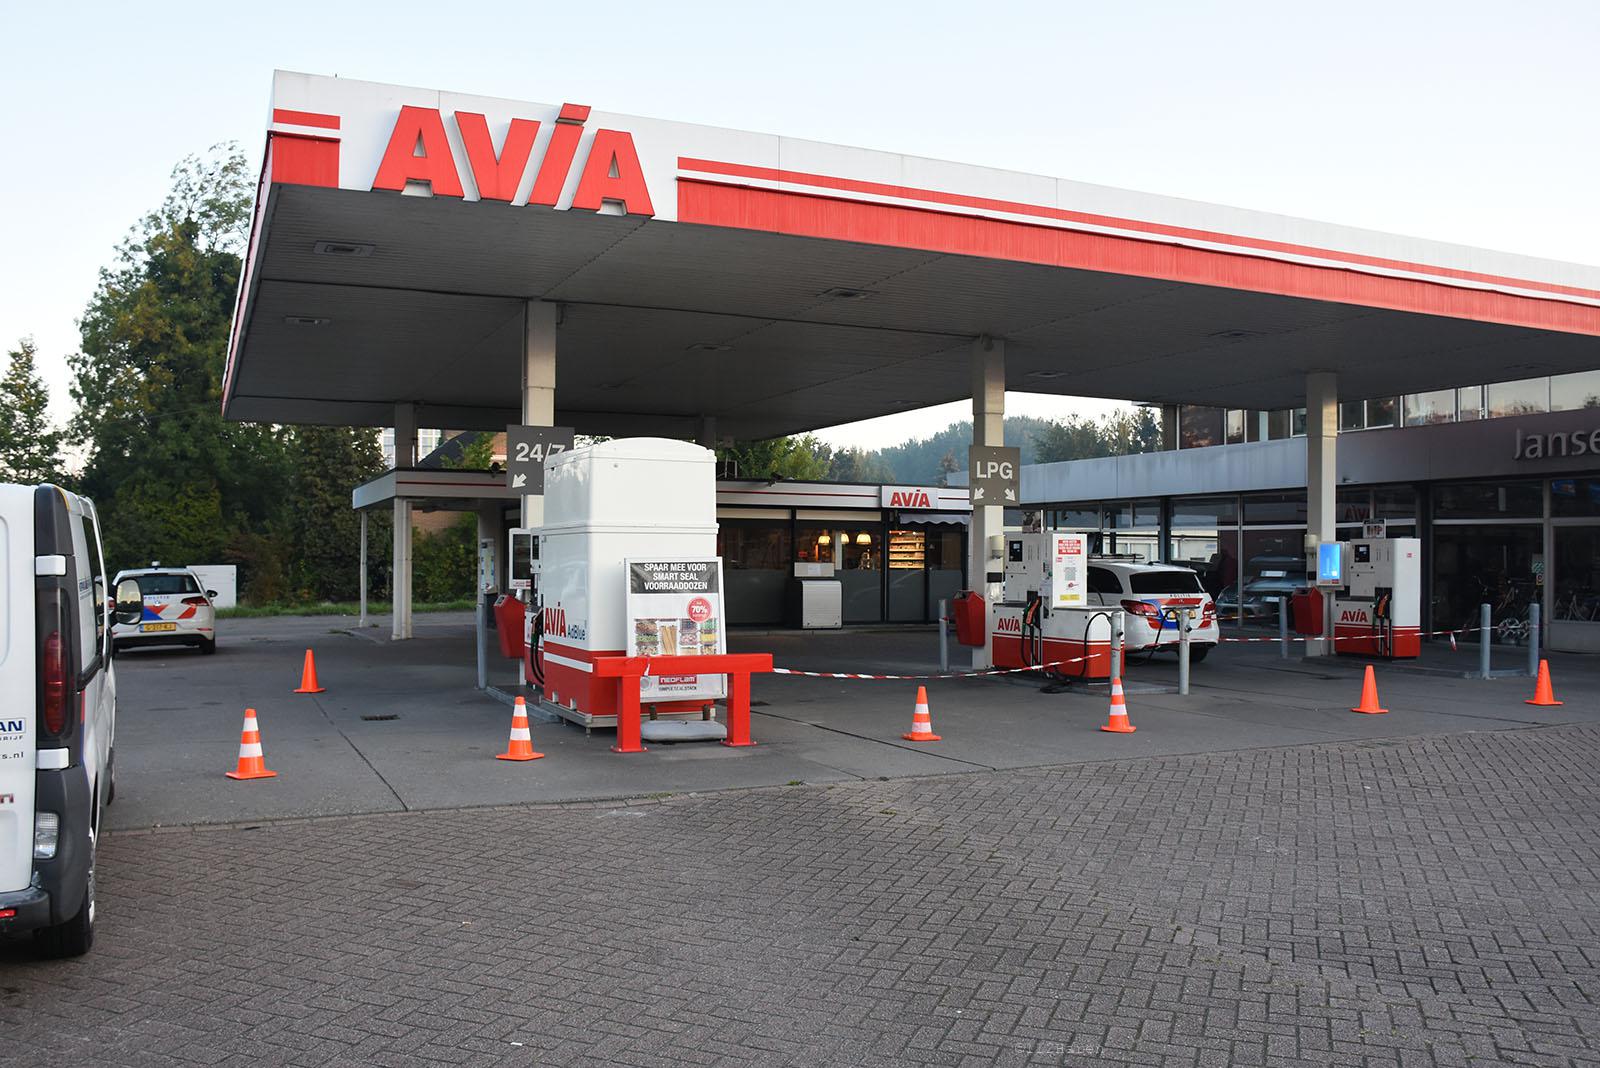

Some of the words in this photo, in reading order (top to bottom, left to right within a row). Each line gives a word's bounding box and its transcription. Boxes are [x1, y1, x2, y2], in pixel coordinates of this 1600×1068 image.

[372, 103, 655, 216] AVIA
[976, 461, 1013, 480] LPG
[890, 489, 931, 508] AVIA
[644, 563, 669, 572] SPAAR
[670, 563, 686, 572] MEE
[687, 563, 707, 572] VOOR
[653, 572, 679, 581] SMART
[680, 572, 699, 581] SEAL
[644, 581, 708, 590] VOORRAADDOZEN
[691, 605, 708, 614] 70%
[1341, 608, 1369, 623] AVIA
[544, 601, 567, 638] AVIA
[997, 615, 1021, 632] AVIA
[567, 624, 586, 641] AdBlue
